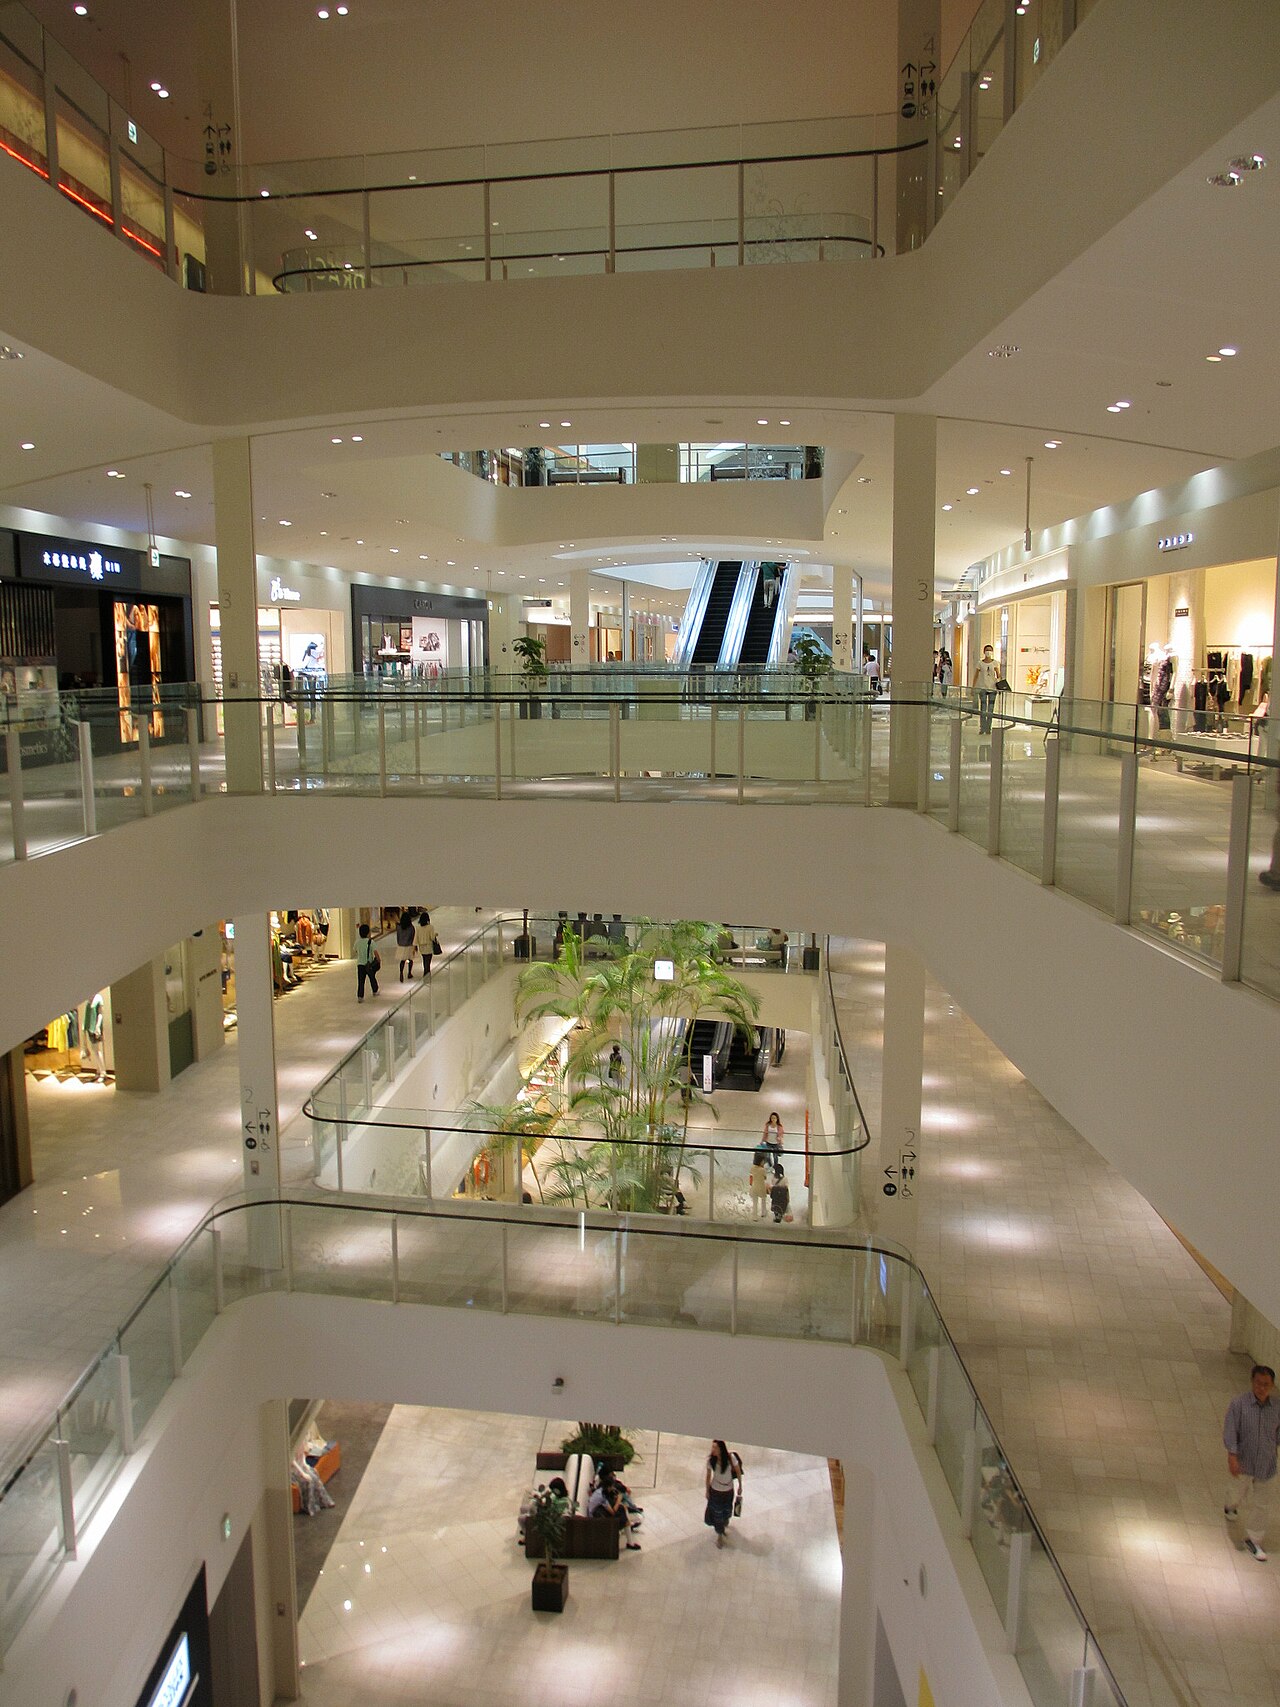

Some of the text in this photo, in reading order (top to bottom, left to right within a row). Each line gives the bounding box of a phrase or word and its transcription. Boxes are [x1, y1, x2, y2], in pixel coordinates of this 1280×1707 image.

[923, 36, 936, 56] 4
[917, 582, 929, 601] 3
[223, 592, 232, 609] 3
[244, 1088, 254, 1104] 2
[904, 1130, 915, 1147] 2
